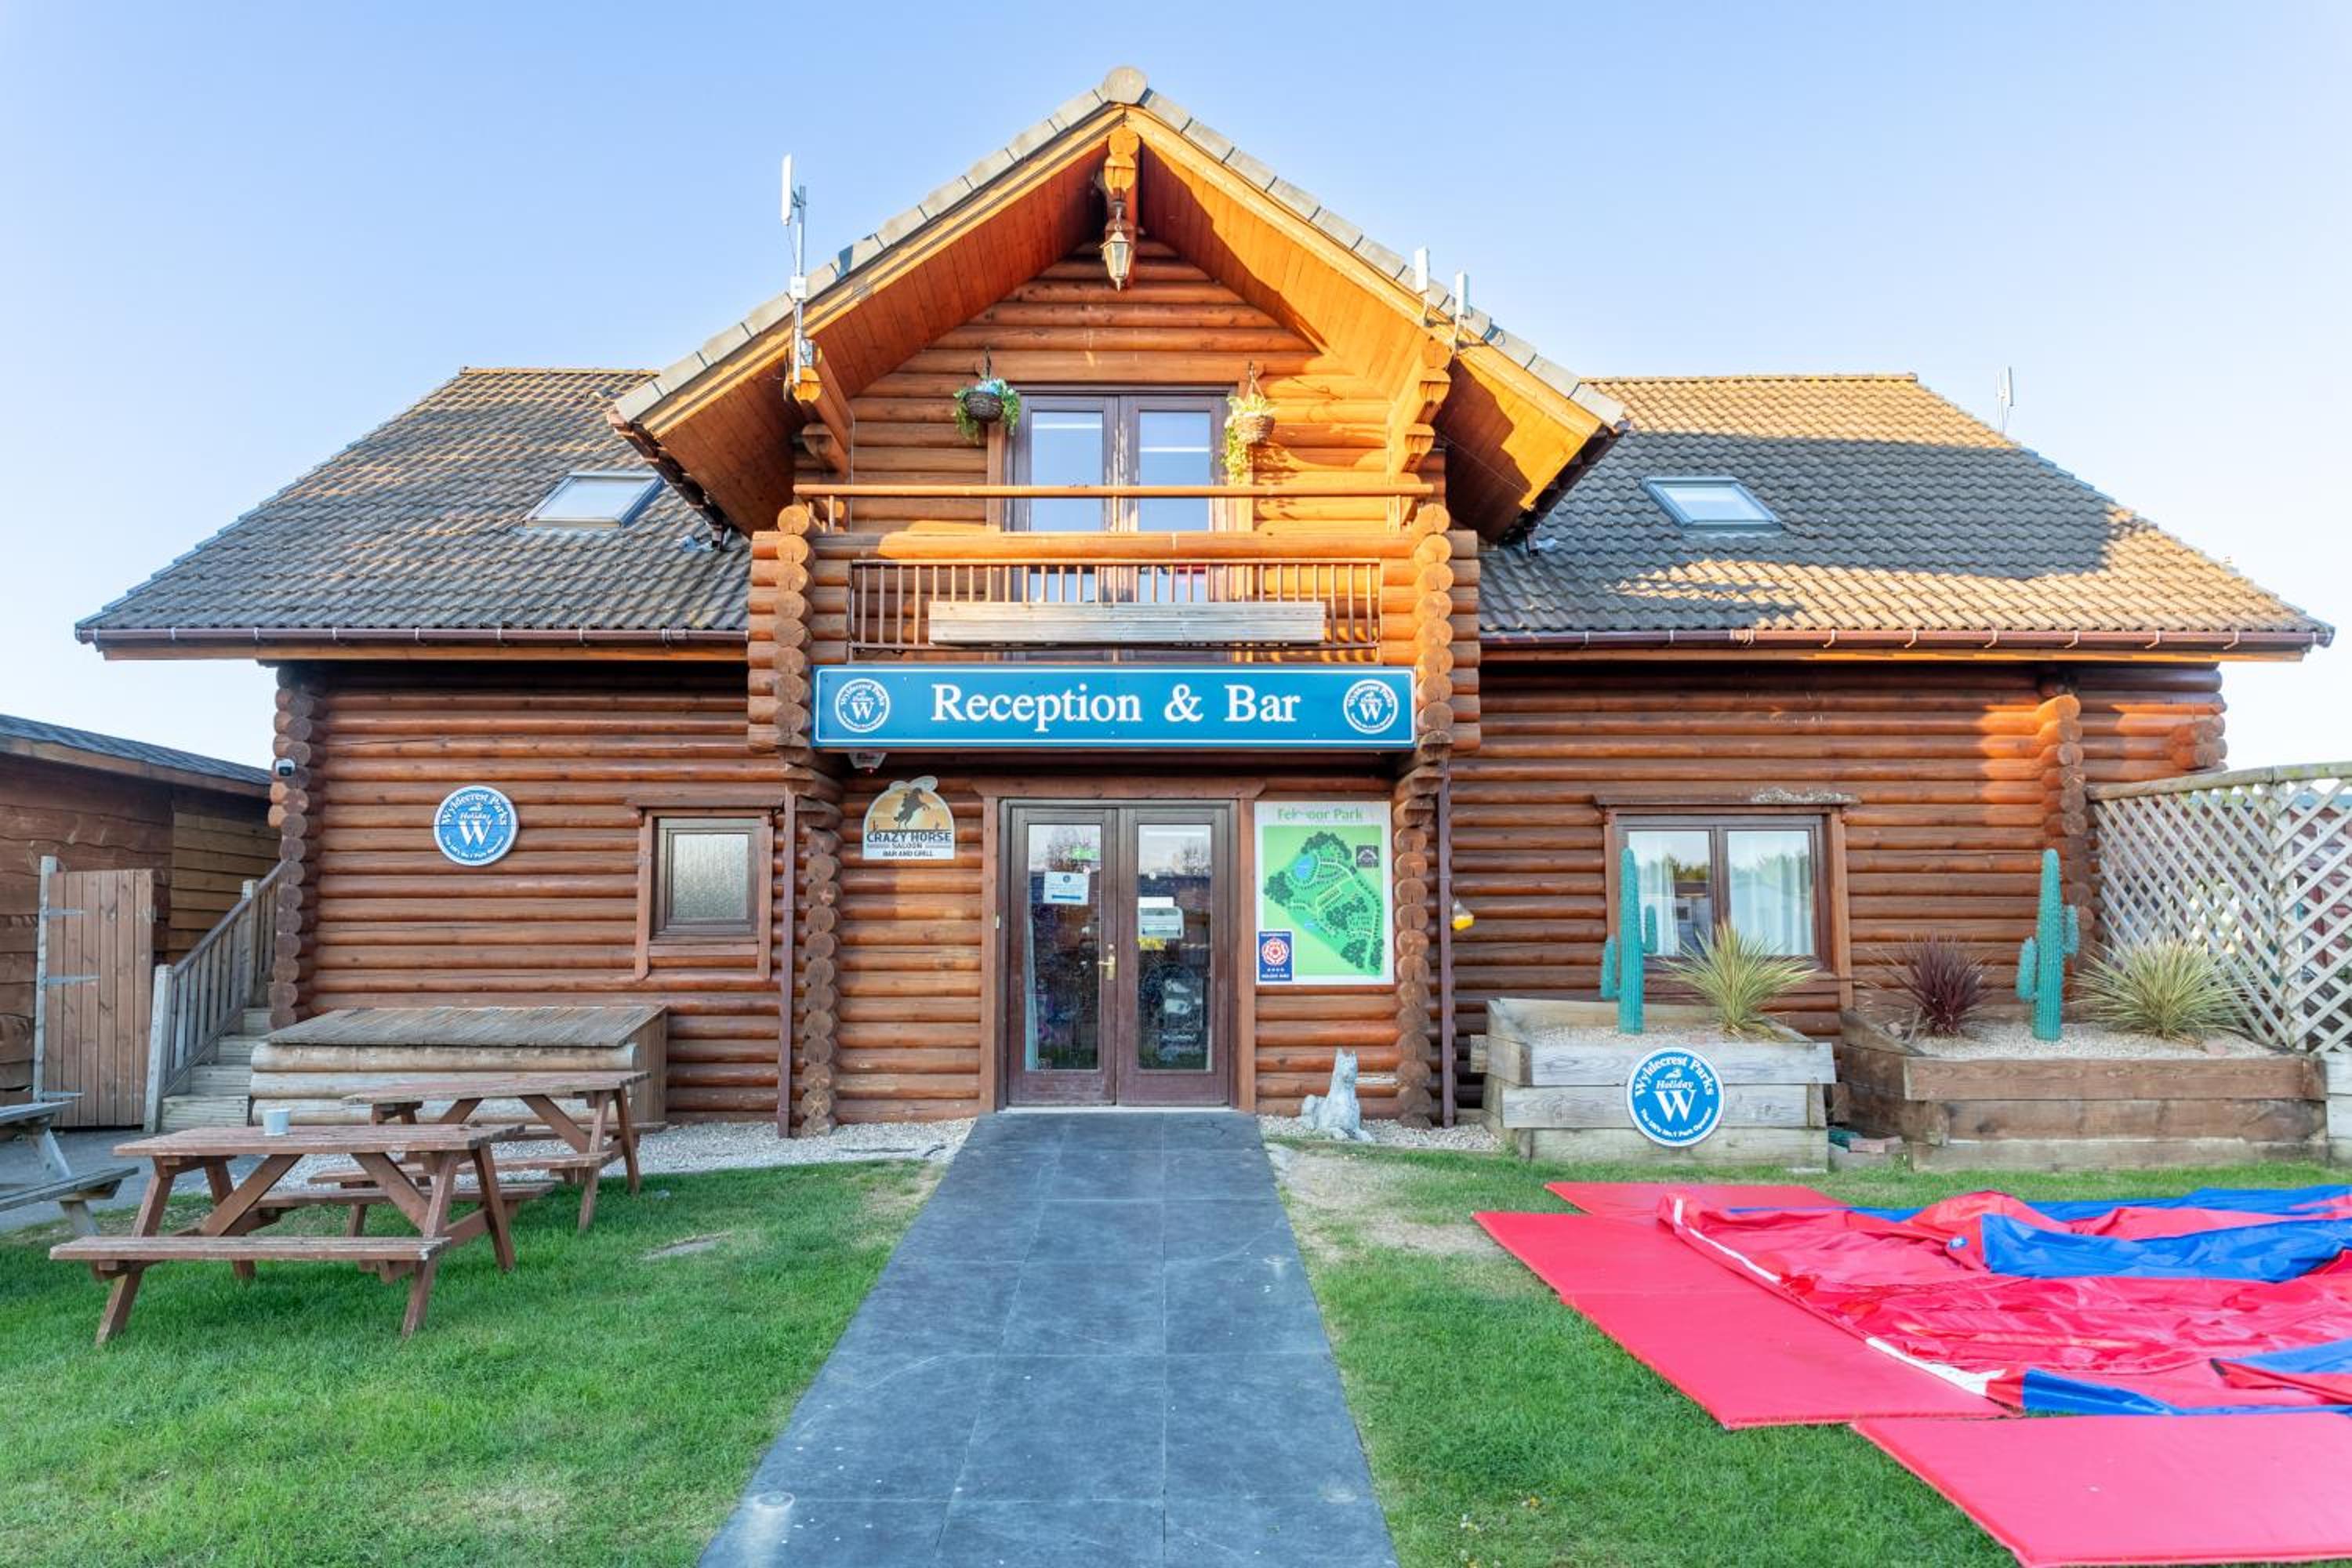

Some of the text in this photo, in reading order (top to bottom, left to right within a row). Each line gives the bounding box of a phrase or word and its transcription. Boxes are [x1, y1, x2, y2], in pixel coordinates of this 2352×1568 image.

[850, 702, 875, 720] W
[931, 683, 1301, 732] Reception & Bar
[1359, 702, 1383, 721] W
[441, 793, 509, 826] Wyldecrest Parks
[1334, 808, 1363, 821] Park
[458, 819, 493, 847] W
[866, 832, 952, 843] CRAZY HORSE
[1635, 1056, 1715, 1098] Wyldecrest Parks
[1656, 1080, 1694, 1091] Holiday
[1653, 1089, 1697, 1123] W
